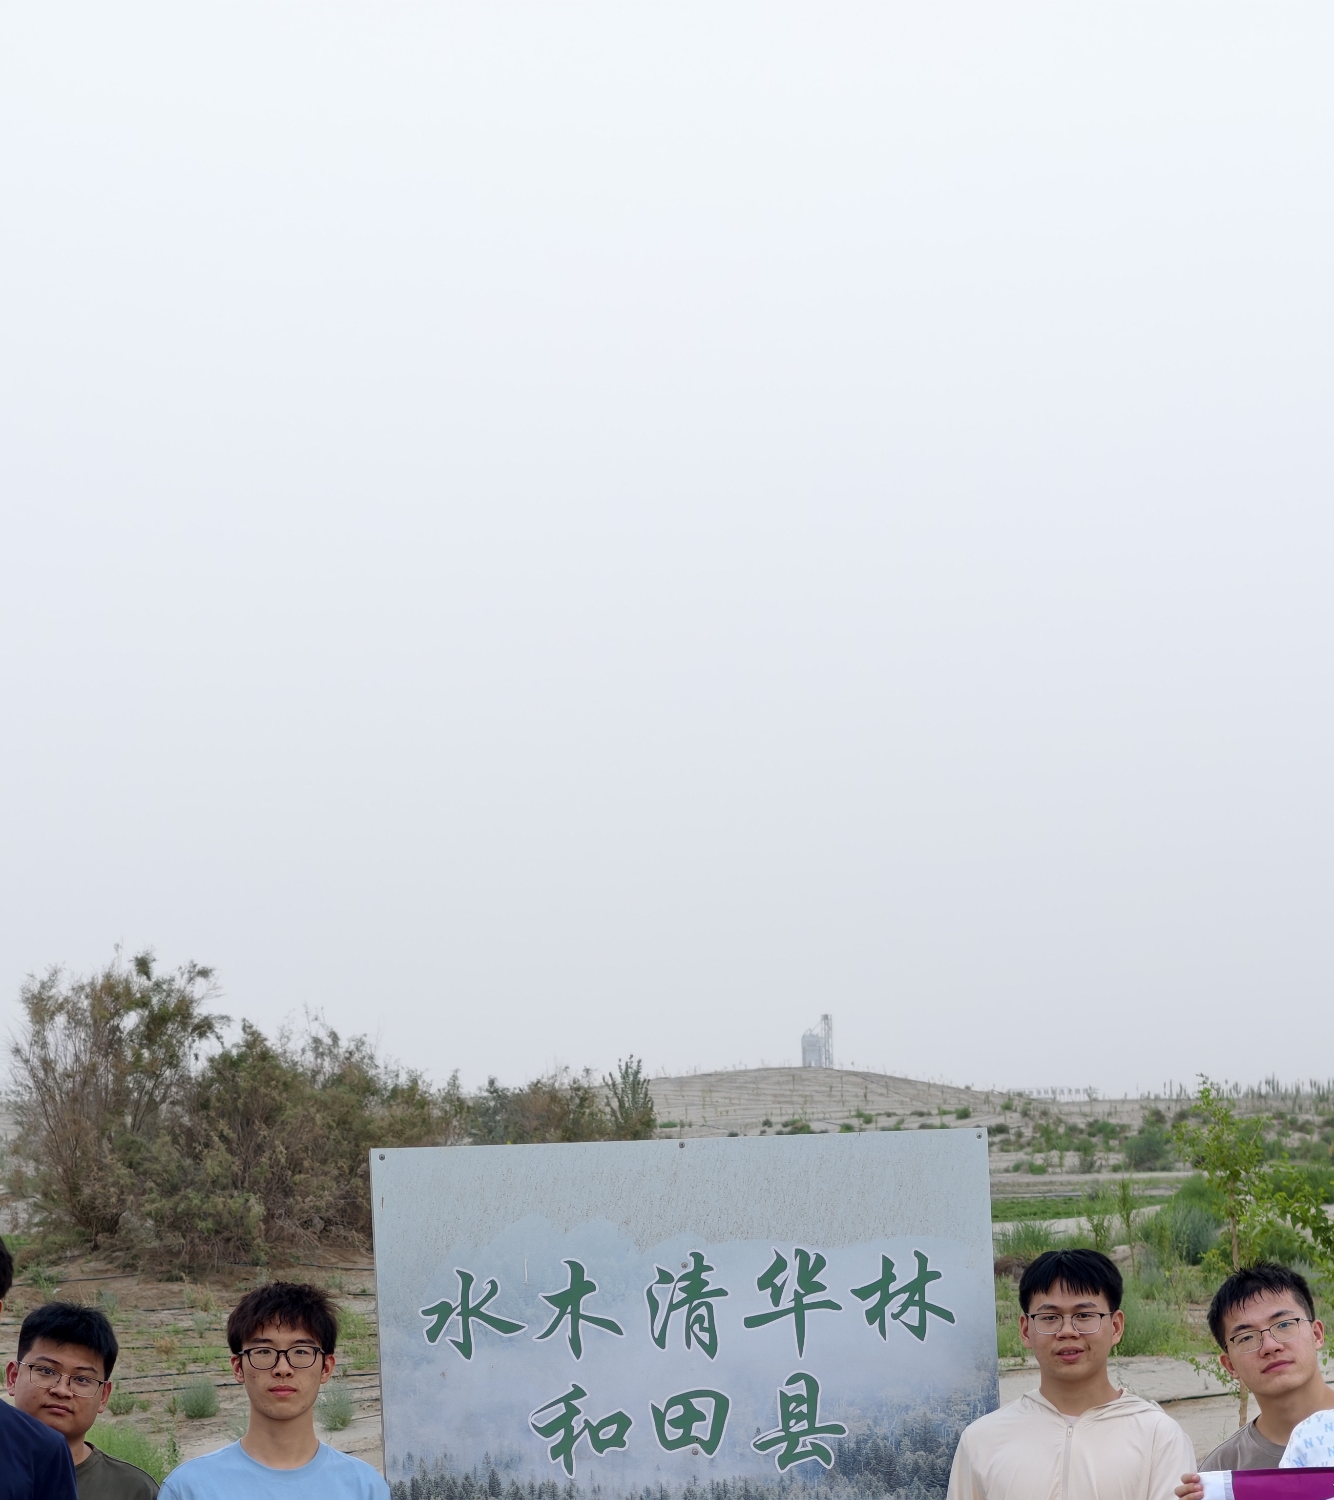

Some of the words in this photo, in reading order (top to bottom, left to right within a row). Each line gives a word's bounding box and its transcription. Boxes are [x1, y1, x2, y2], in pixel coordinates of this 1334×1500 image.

[420, 1247, 956, 1360] 水木清华林
[530, 1371, 848, 1479] 和田县
